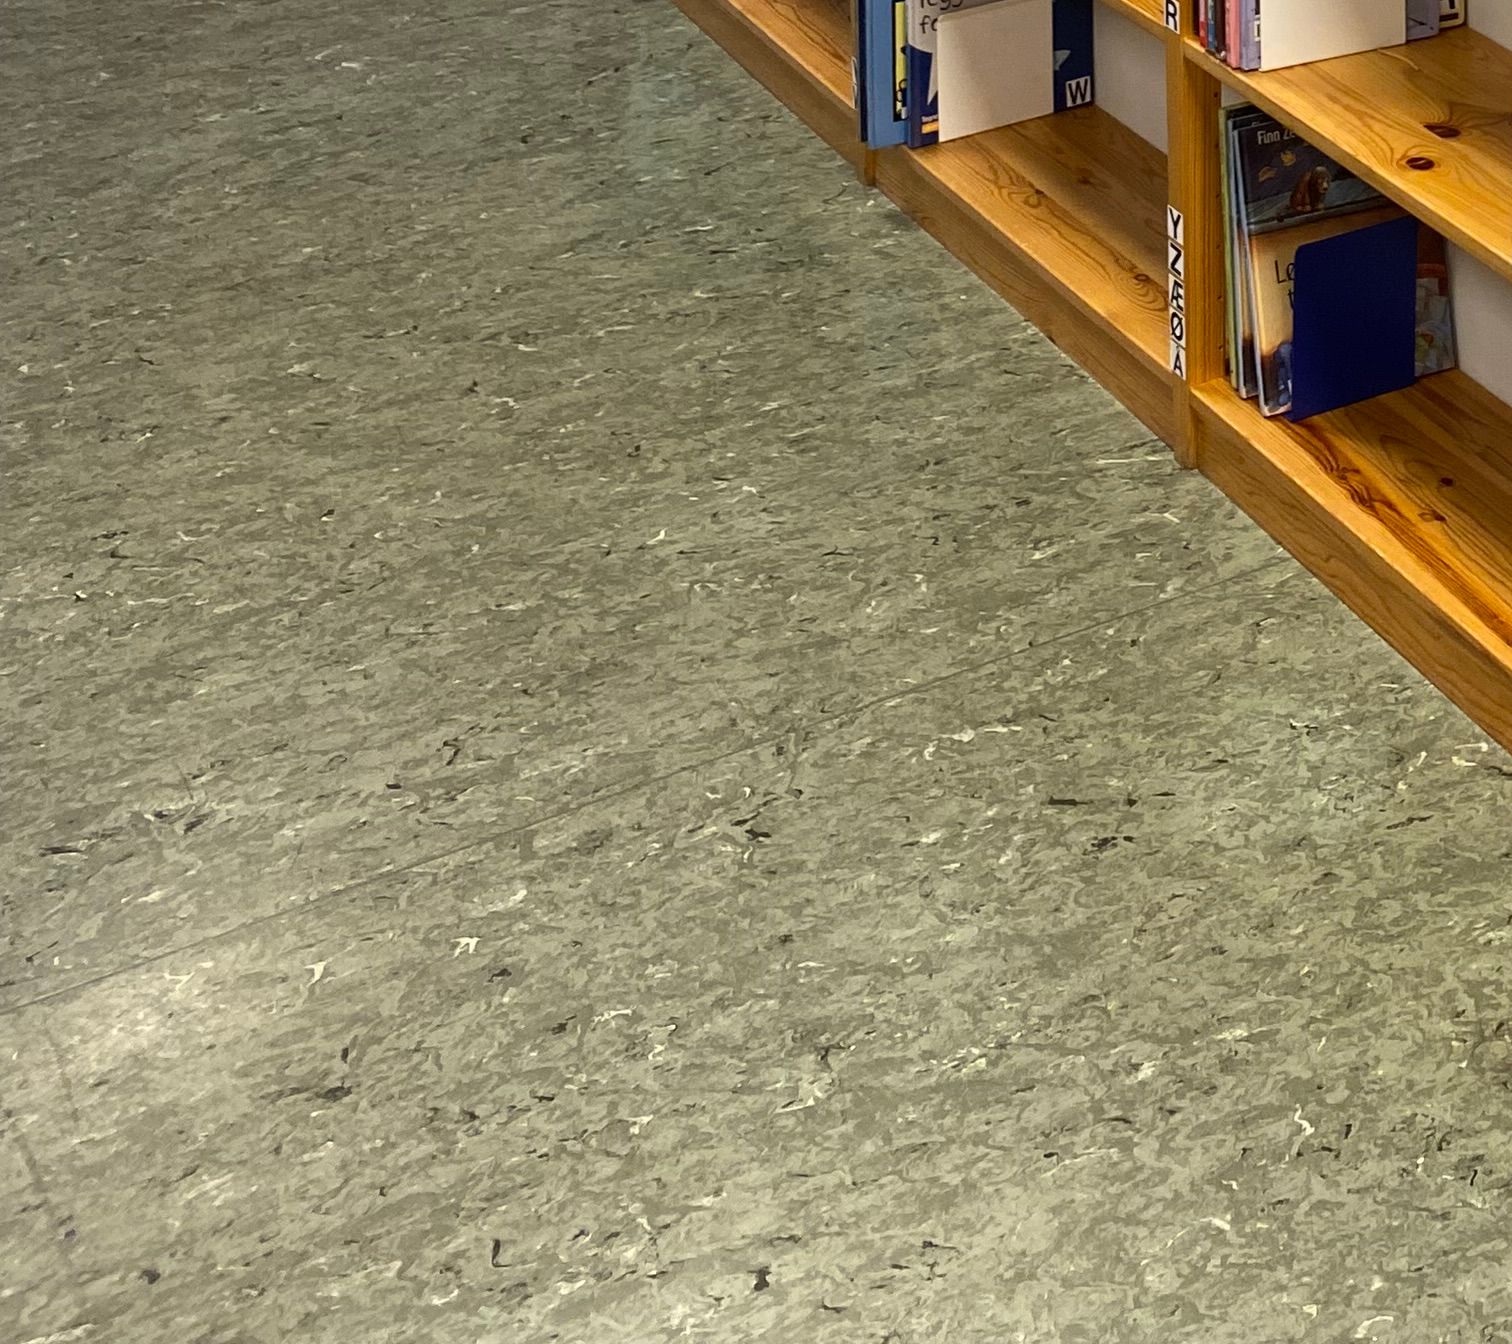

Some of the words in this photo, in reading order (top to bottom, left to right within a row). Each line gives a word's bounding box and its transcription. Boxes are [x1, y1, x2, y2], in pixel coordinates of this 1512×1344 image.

[1068, 79, 1089, 106] W
[1257, 129, 1281, 146] Finn
[1169, 208, 1182, 239] Y
[1169, 243, 1182, 276] Z
[1170, 279, 1184, 312] Æ
[1170, 312, 1184, 342] Ø
[1172, 345, 1184, 378] Å
